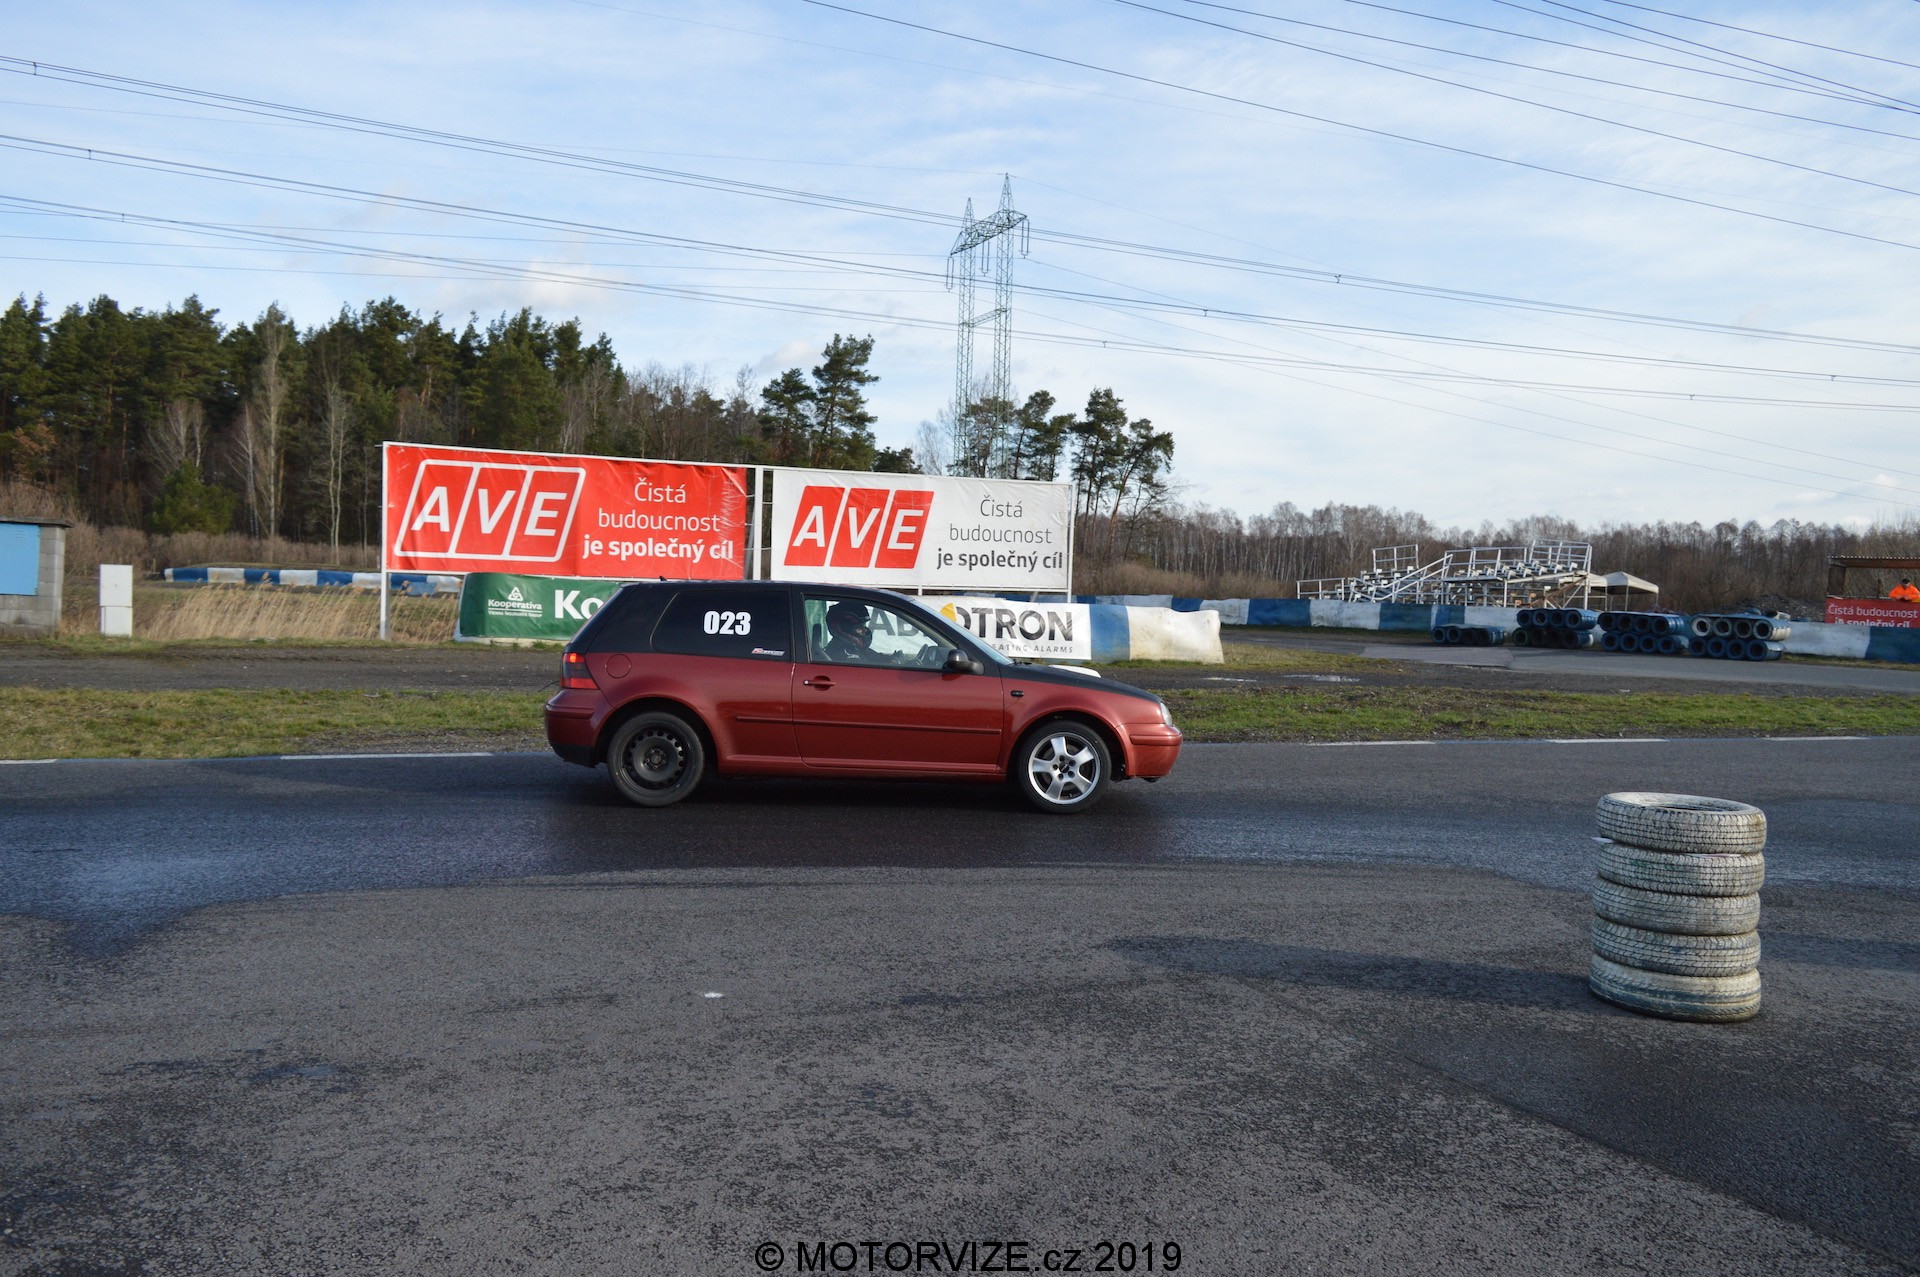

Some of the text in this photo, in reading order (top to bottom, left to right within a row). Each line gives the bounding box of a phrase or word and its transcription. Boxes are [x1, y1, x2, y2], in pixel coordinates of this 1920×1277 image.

[634, 477, 687, 504] Čistá
[411, 486, 568, 537] AVE
[980, 494, 1023, 518] Čistá
[598, 507, 721, 532] budoucnost
[792, 505, 924, 550] AVE
[949, 523, 1053, 544] budoucnost
[582, 534, 734, 564] je společný cíl
[937, 547, 1063, 573] je společný cíl
[488, 598, 543, 610] Kooperativa
[1828, 603, 1918, 618] Čistá budoucnost
[703, 610, 752, 636] 023
[1034, 645, 1074, 654] ALARMS
